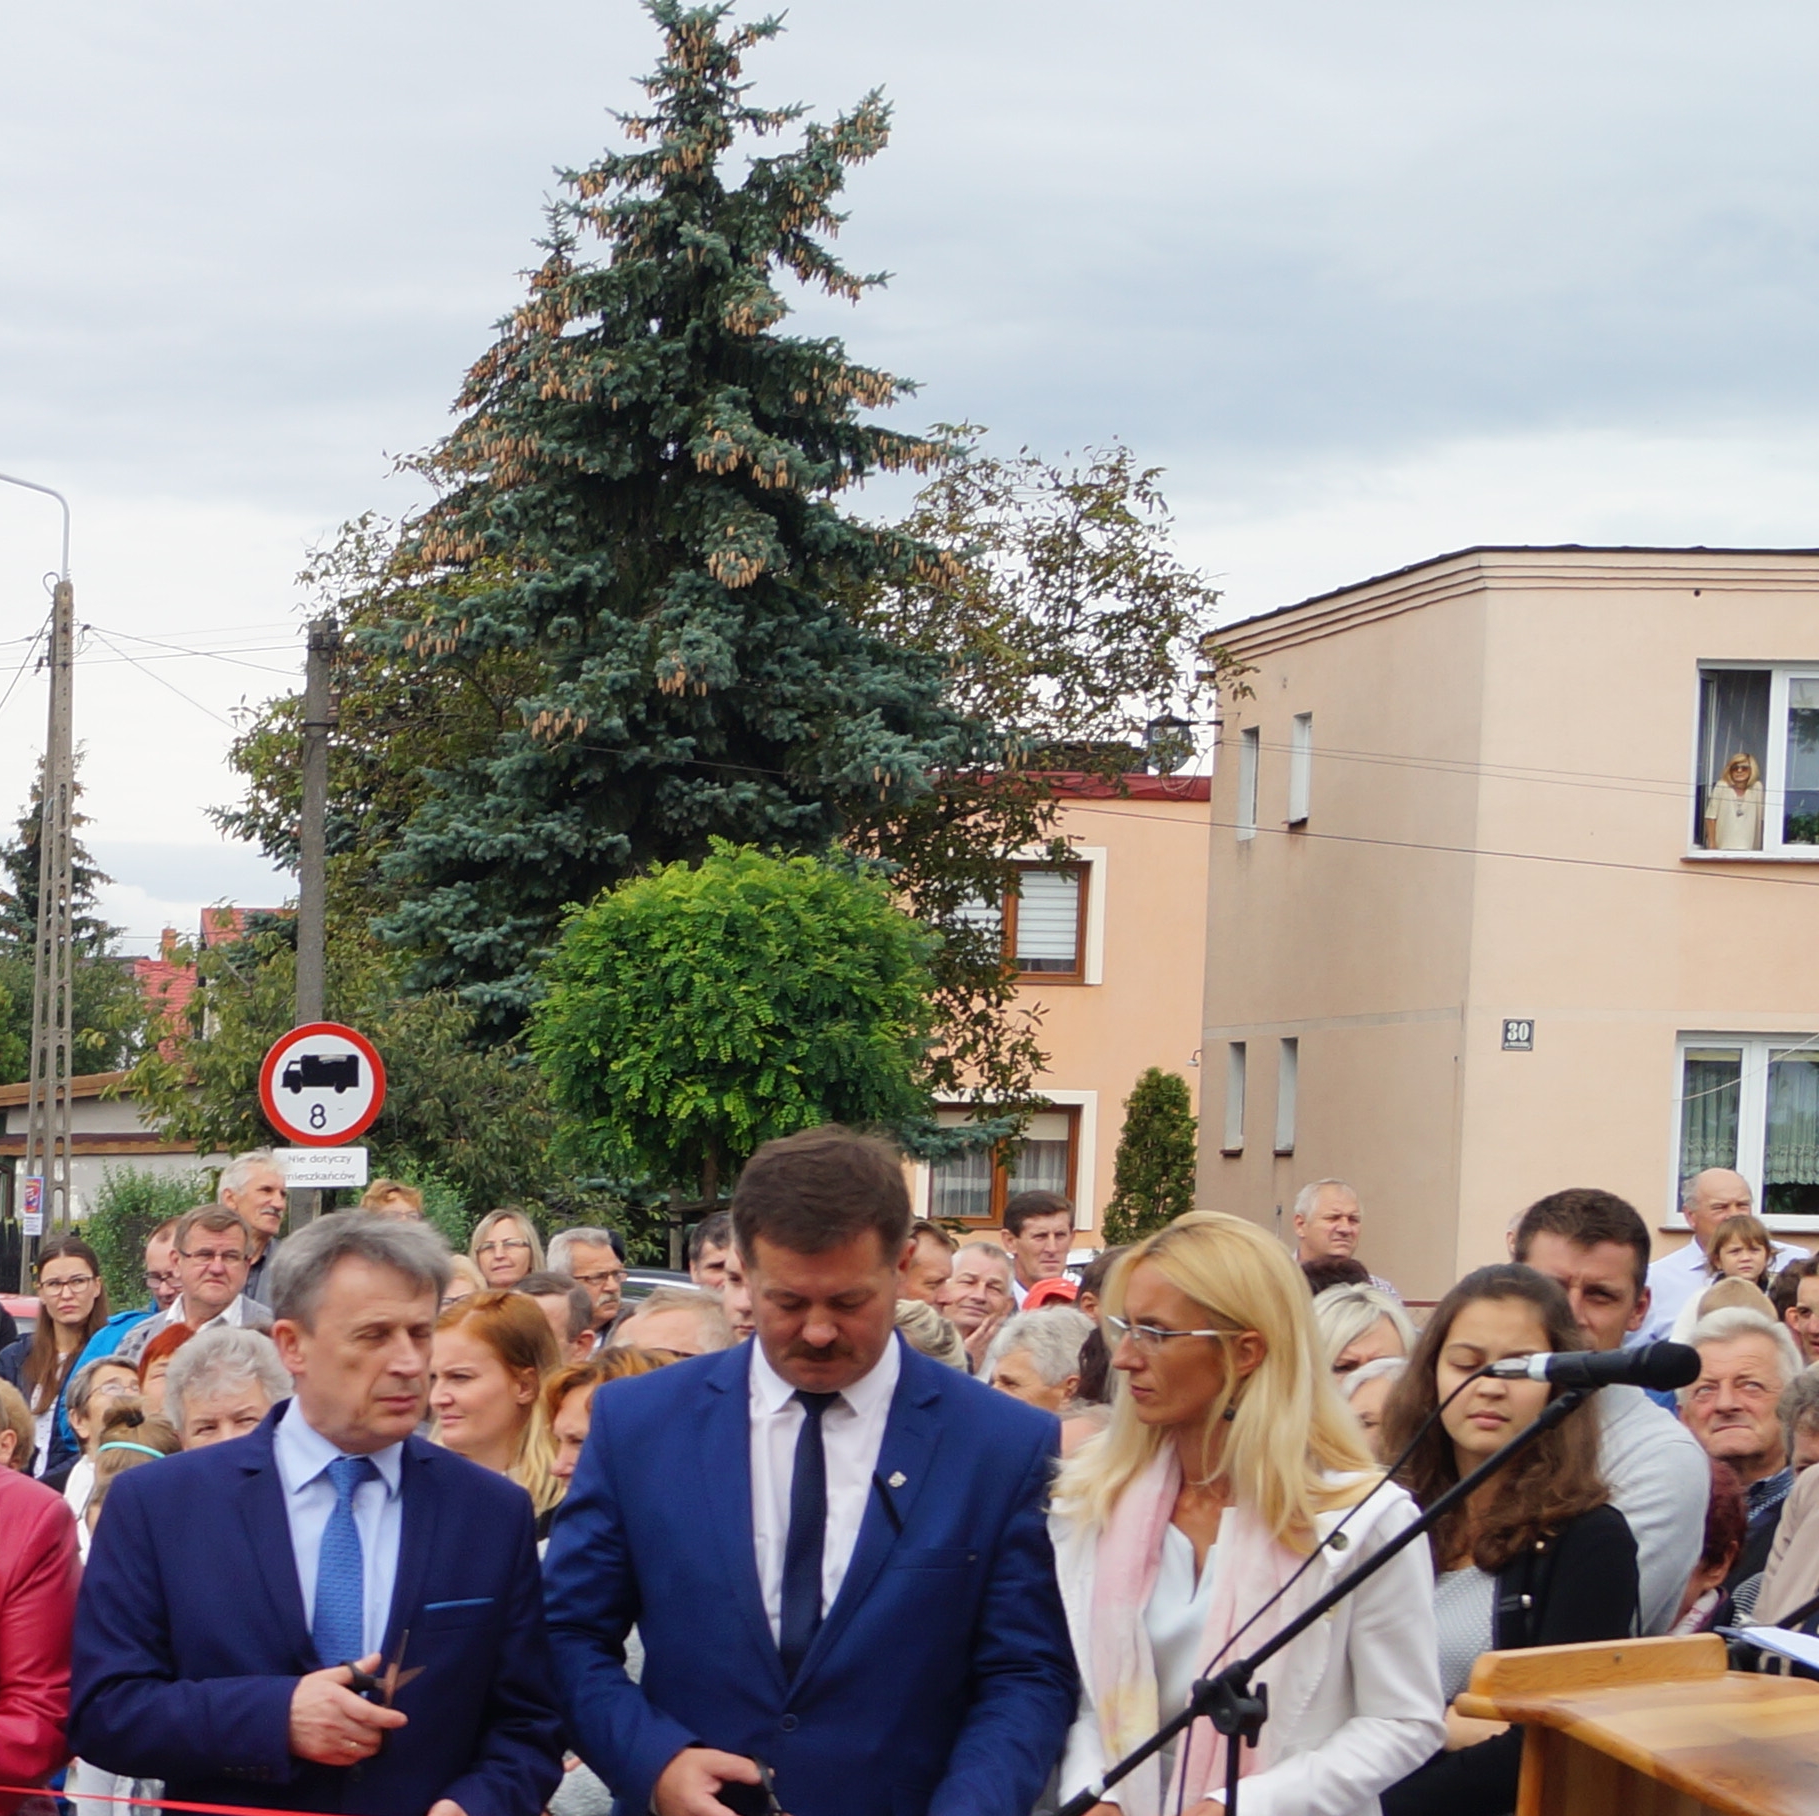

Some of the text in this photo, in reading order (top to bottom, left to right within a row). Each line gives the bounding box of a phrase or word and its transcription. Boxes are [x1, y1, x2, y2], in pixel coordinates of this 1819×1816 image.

[1507, 1022, 1530, 1041] 30
[309, 1103, 326, 1129] 8
[288, 1153, 352, 1165] Nie dotyczy
